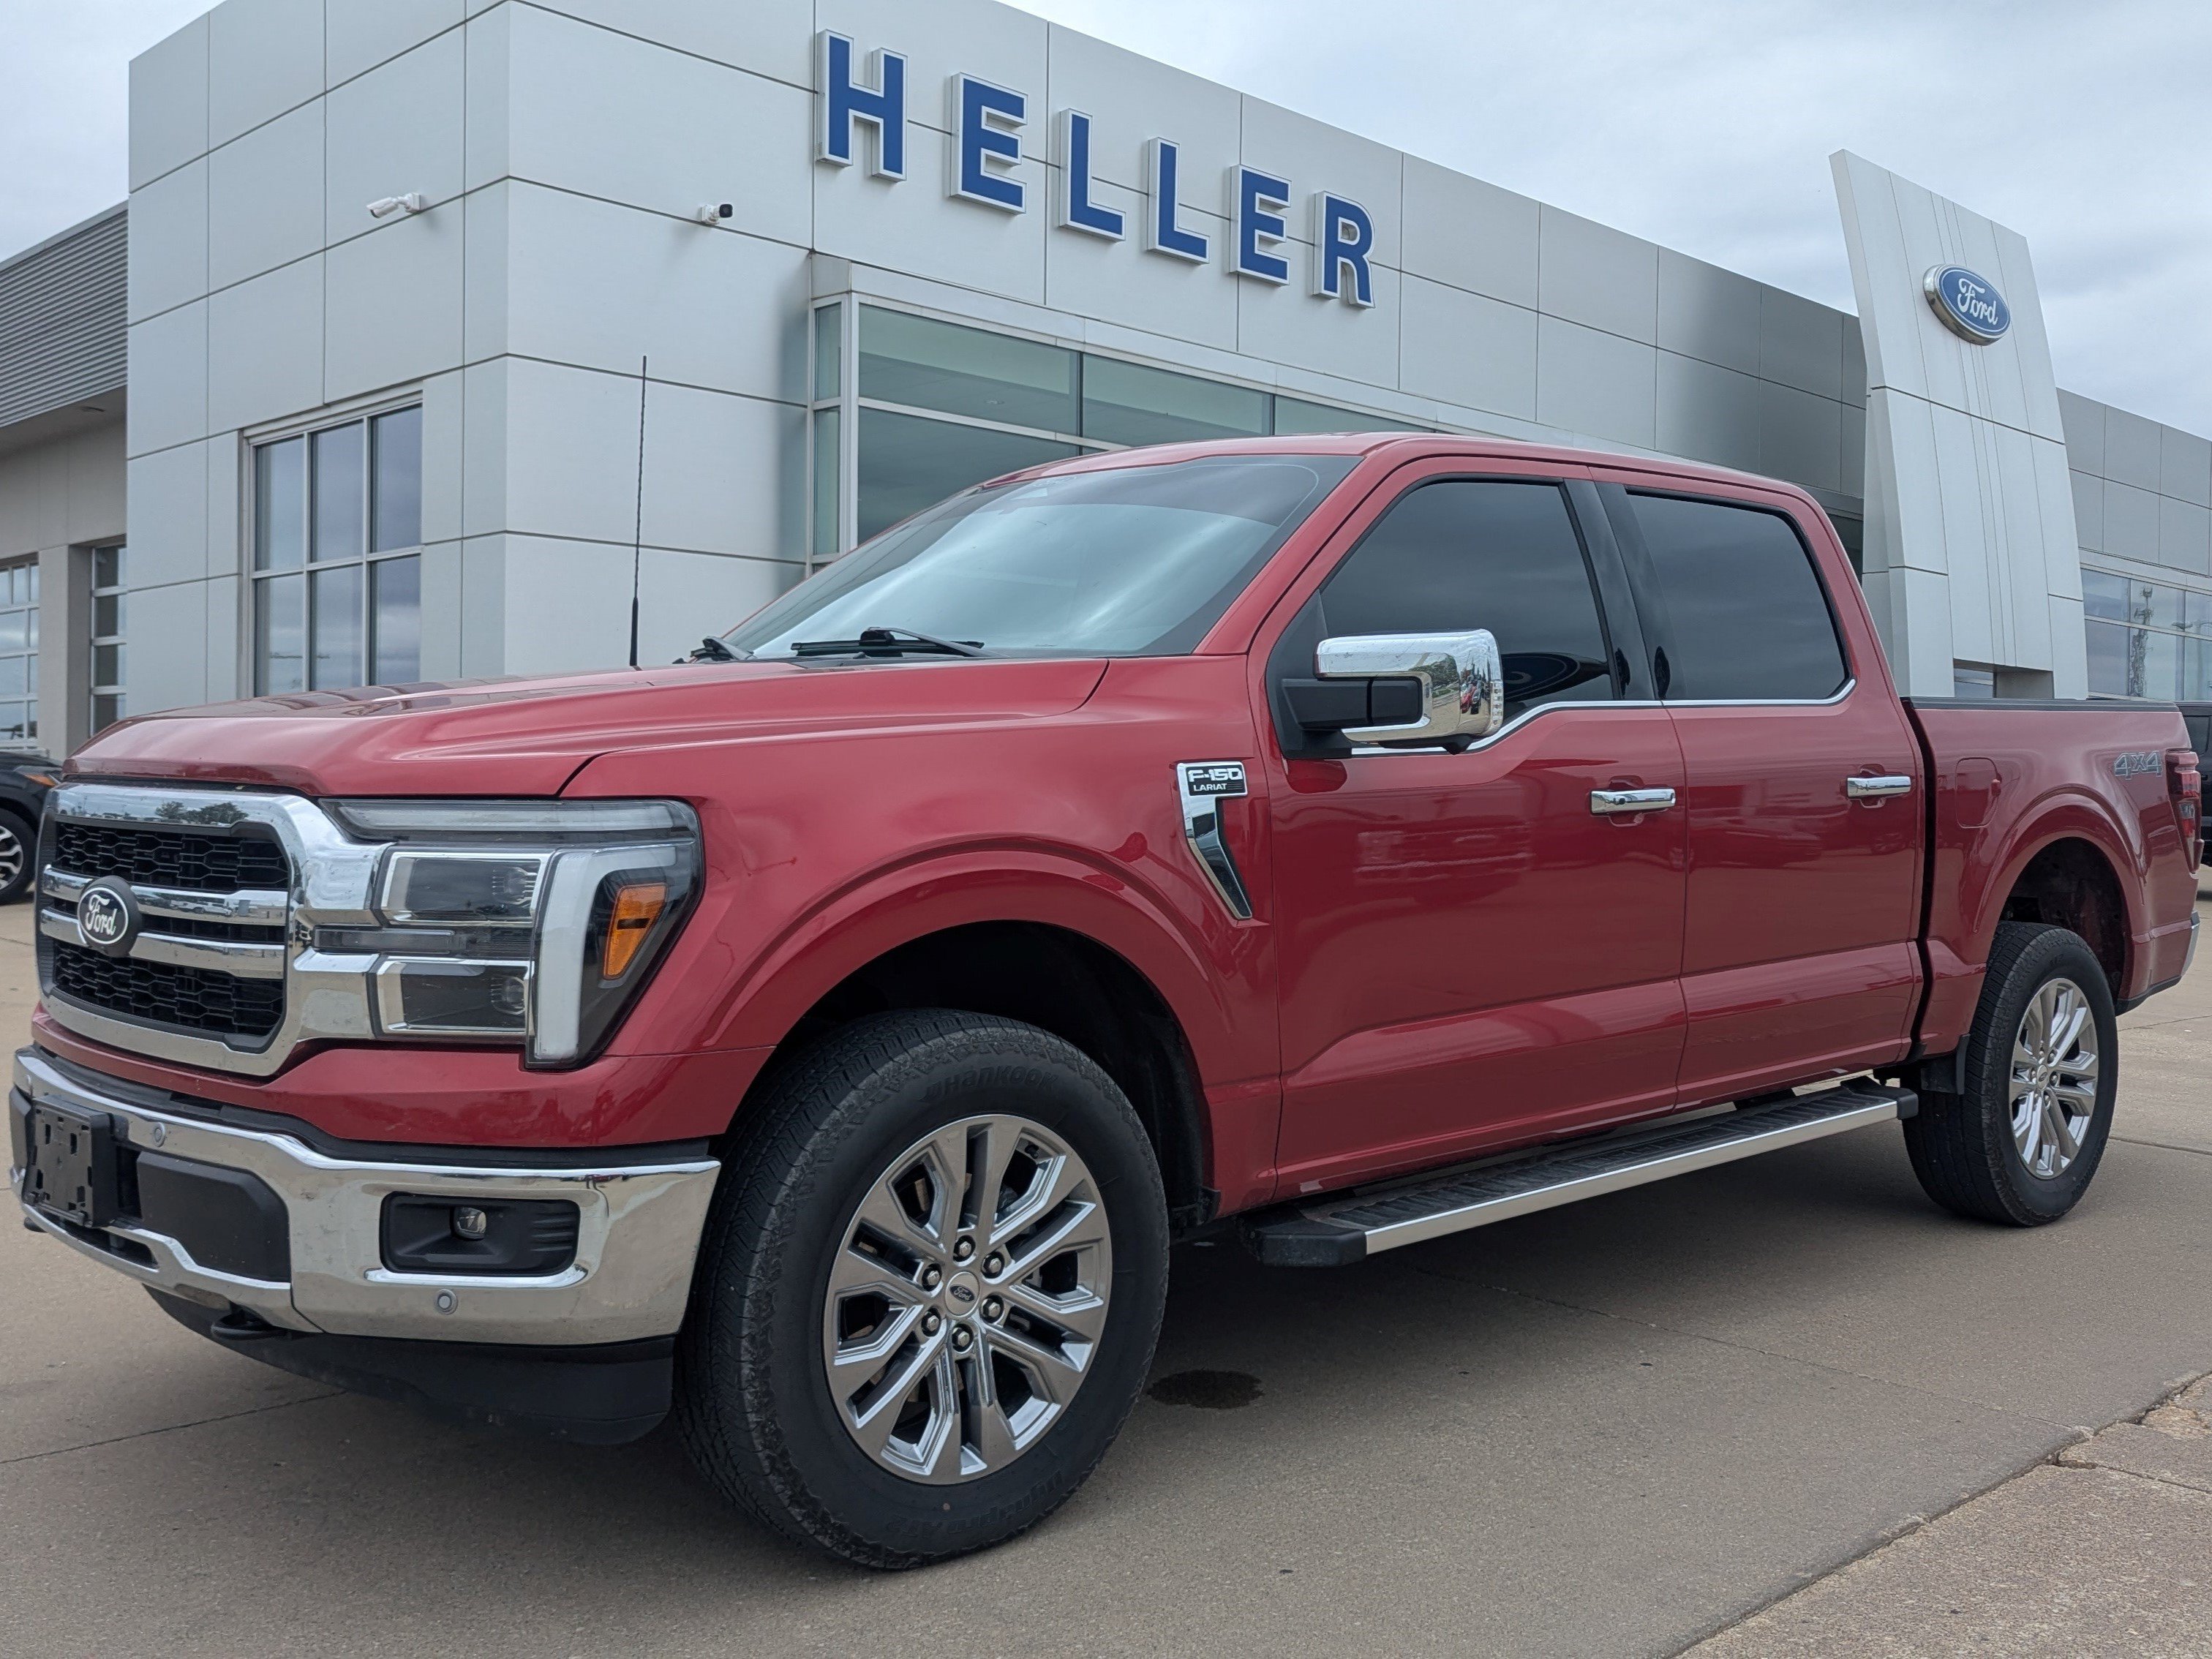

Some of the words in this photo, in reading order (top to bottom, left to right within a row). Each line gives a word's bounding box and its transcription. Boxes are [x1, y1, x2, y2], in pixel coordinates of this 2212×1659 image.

[816, 29, 1376, 309] HELLER
[1957, 278, 1998, 325] Ford
[1188, 768, 1243, 782] F-150
[1193, 783, 1227, 791] LARIAT
[85, 894, 118, 936] Ford
[954, 1286, 971, 1301] Ford
